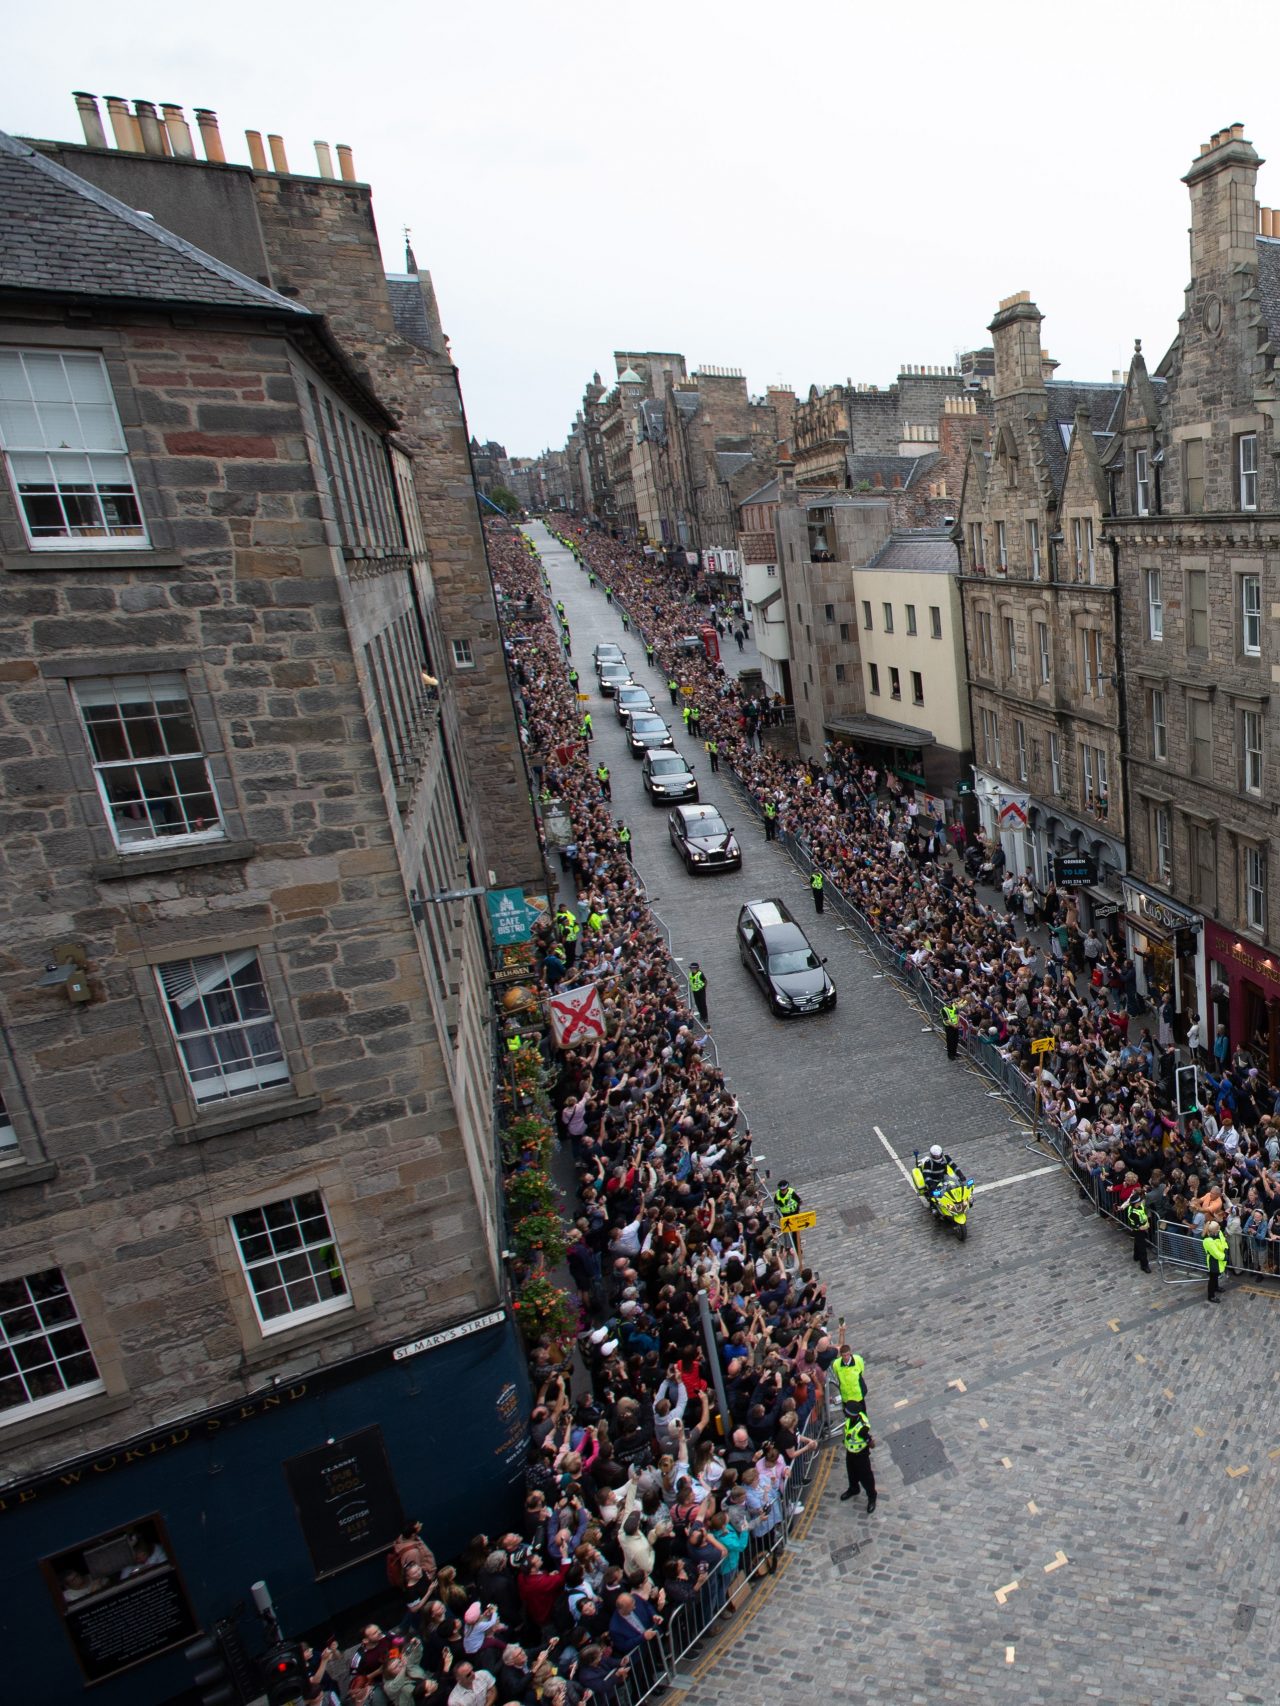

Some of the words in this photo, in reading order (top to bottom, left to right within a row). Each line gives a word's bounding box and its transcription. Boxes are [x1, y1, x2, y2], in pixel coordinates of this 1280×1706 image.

[1063, 868, 1073, 876] TO
[497, 923, 526, 935] BISTRO
[495, 966, 530, 979] BELHAVEN
[414, 1329, 457, 1352] MARY'S
[461, 1311, 502, 1335] STREET
[60, 1418, 221, 1486] WORLDS
[239, 1384, 307, 1419] END
[338, 1507, 370, 1527] SCOTTISH
